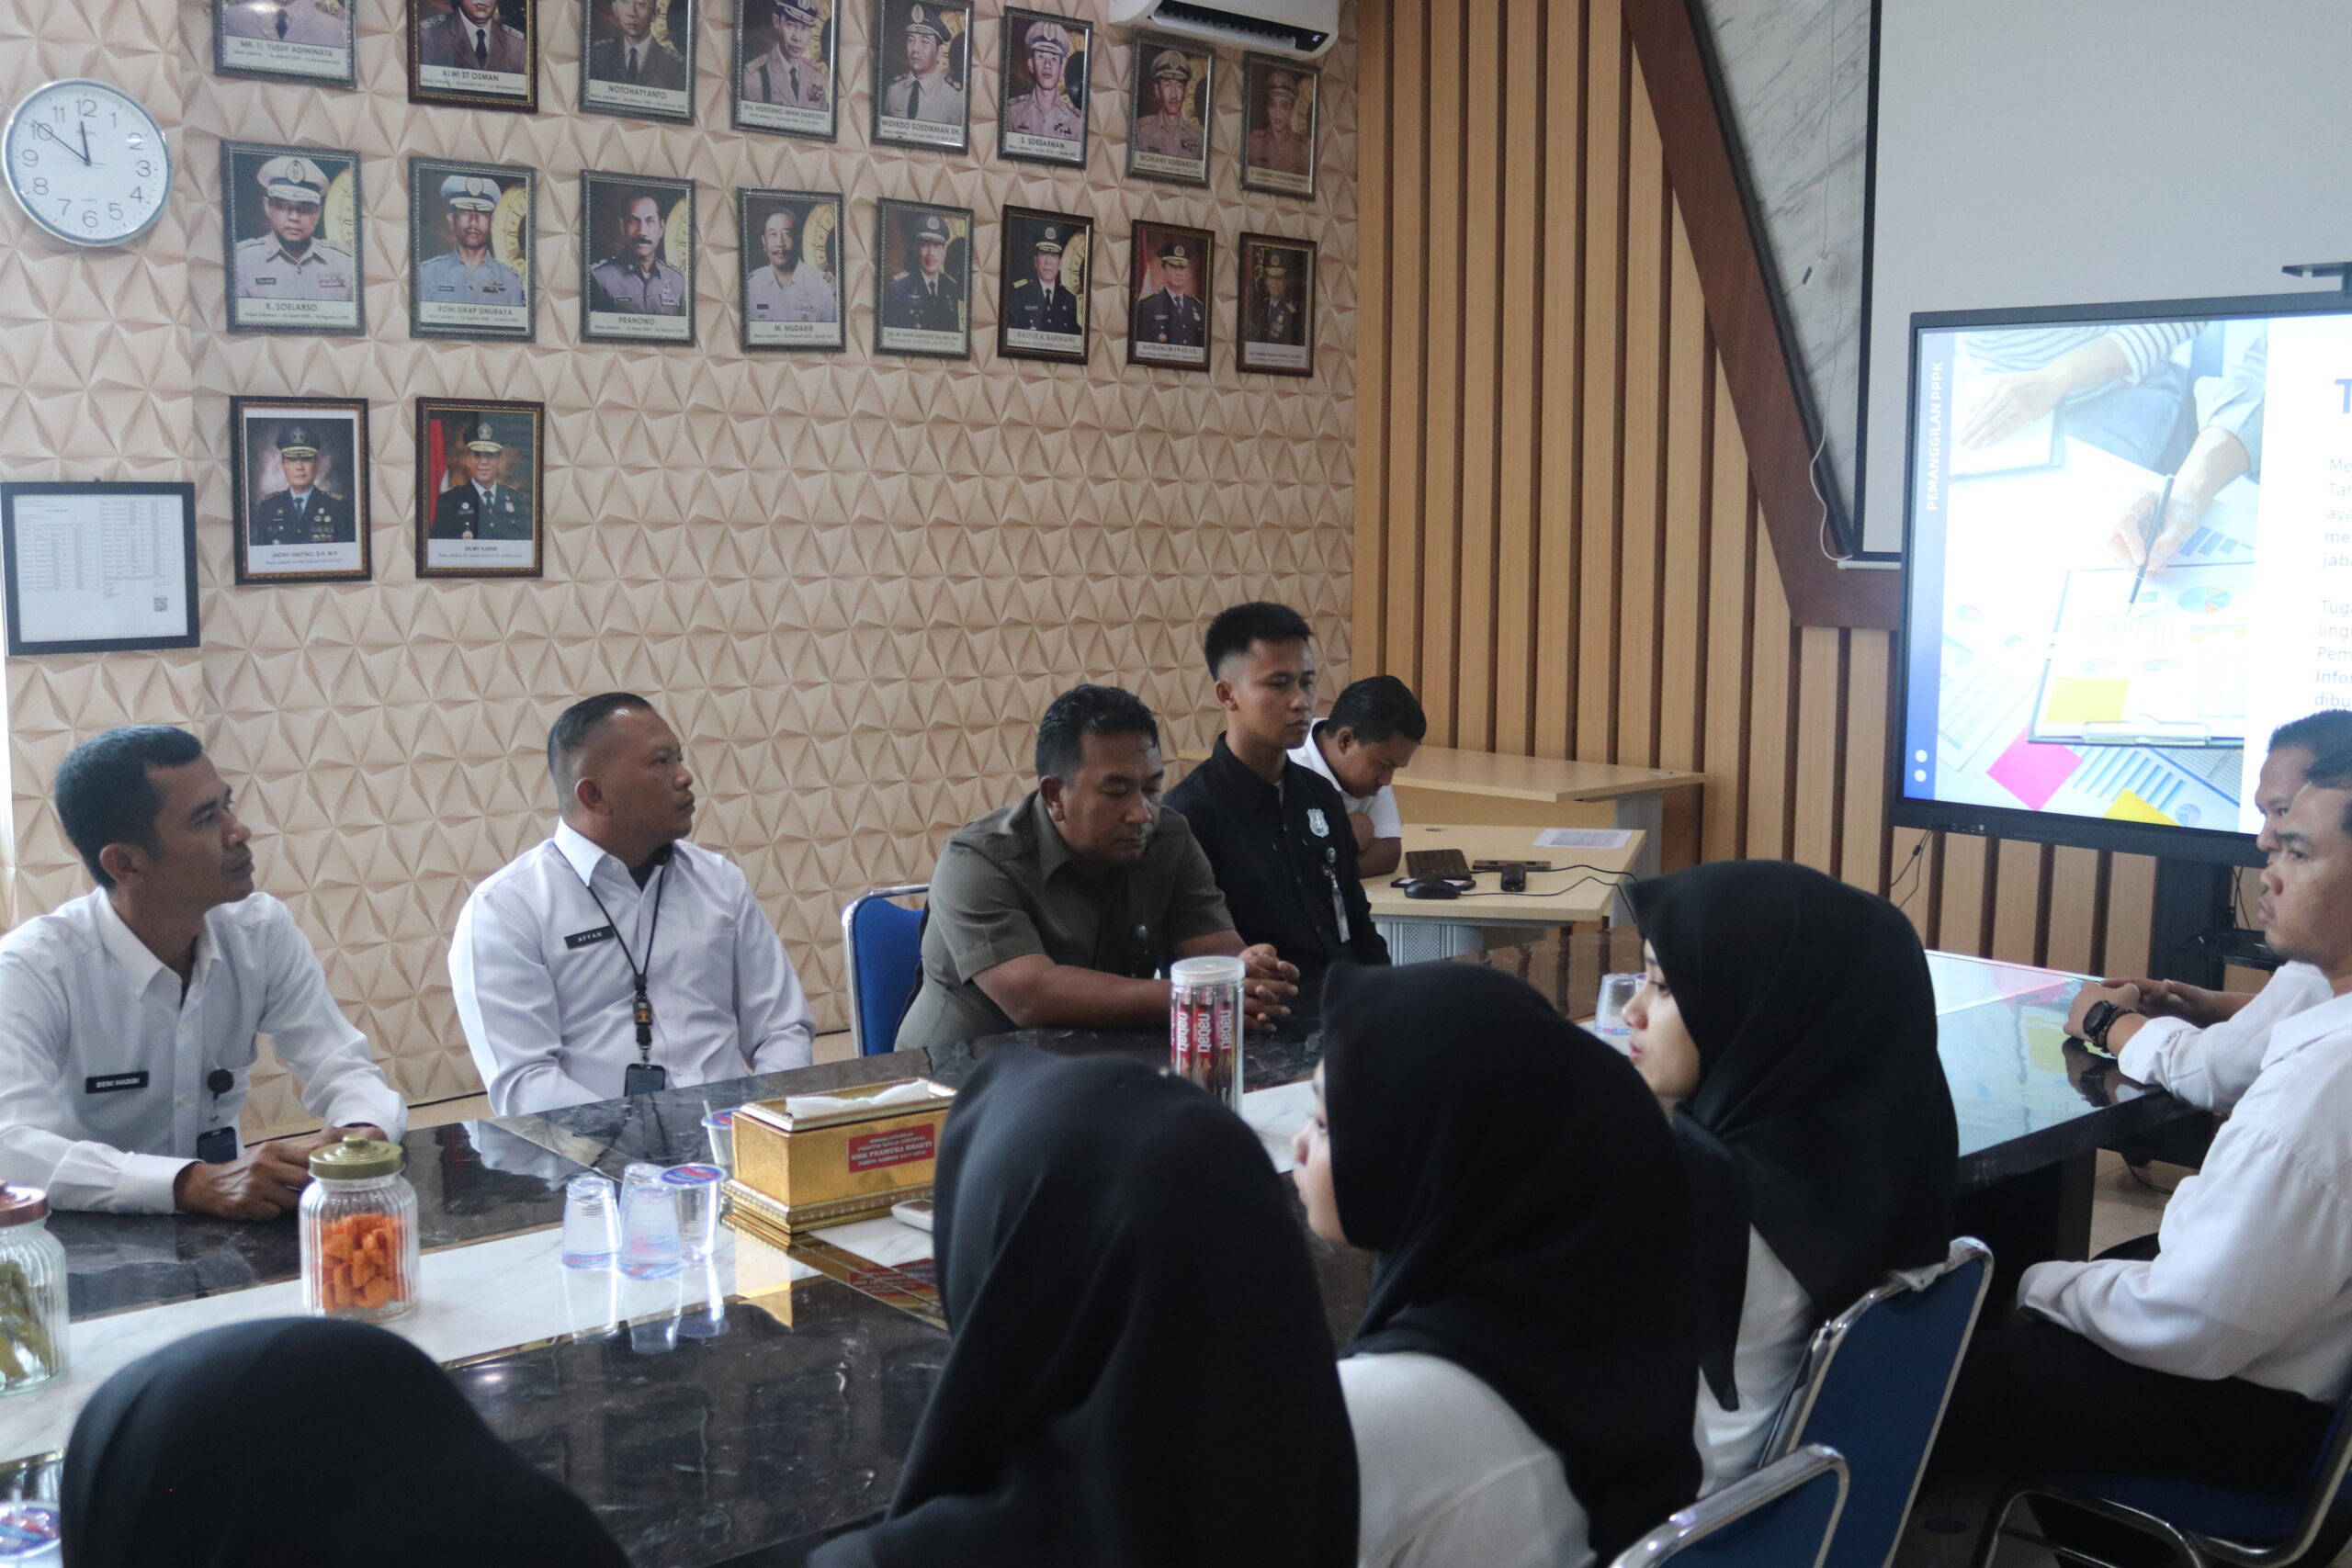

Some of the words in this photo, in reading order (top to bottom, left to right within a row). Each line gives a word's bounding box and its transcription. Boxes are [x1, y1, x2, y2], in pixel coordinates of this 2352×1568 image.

[52, 106, 65, 123] 11
[75, 98, 97, 118] 12
[110, 111, 117, 129] 1
[30, 123, 53, 141] 10
[127, 132, 144, 151] 2
[22, 149, 39, 167] 9
[136, 160, 152, 177] 3
[33, 176, 50, 195] 8
[129, 186, 144, 203] 4
[57, 197, 72, 217] 7
[108, 202, 124, 220] 5
[82, 209, 98, 228] 6
[1931, 361, 1944, 400] PPPK
[1927, 402, 1942, 511] PEMANGGILAN
[1176, 1011, 1191, 1053] nabati
[1197, 1012, 1213, 1054] nabati
[1220, 1010, 1232, 1050] nabati
